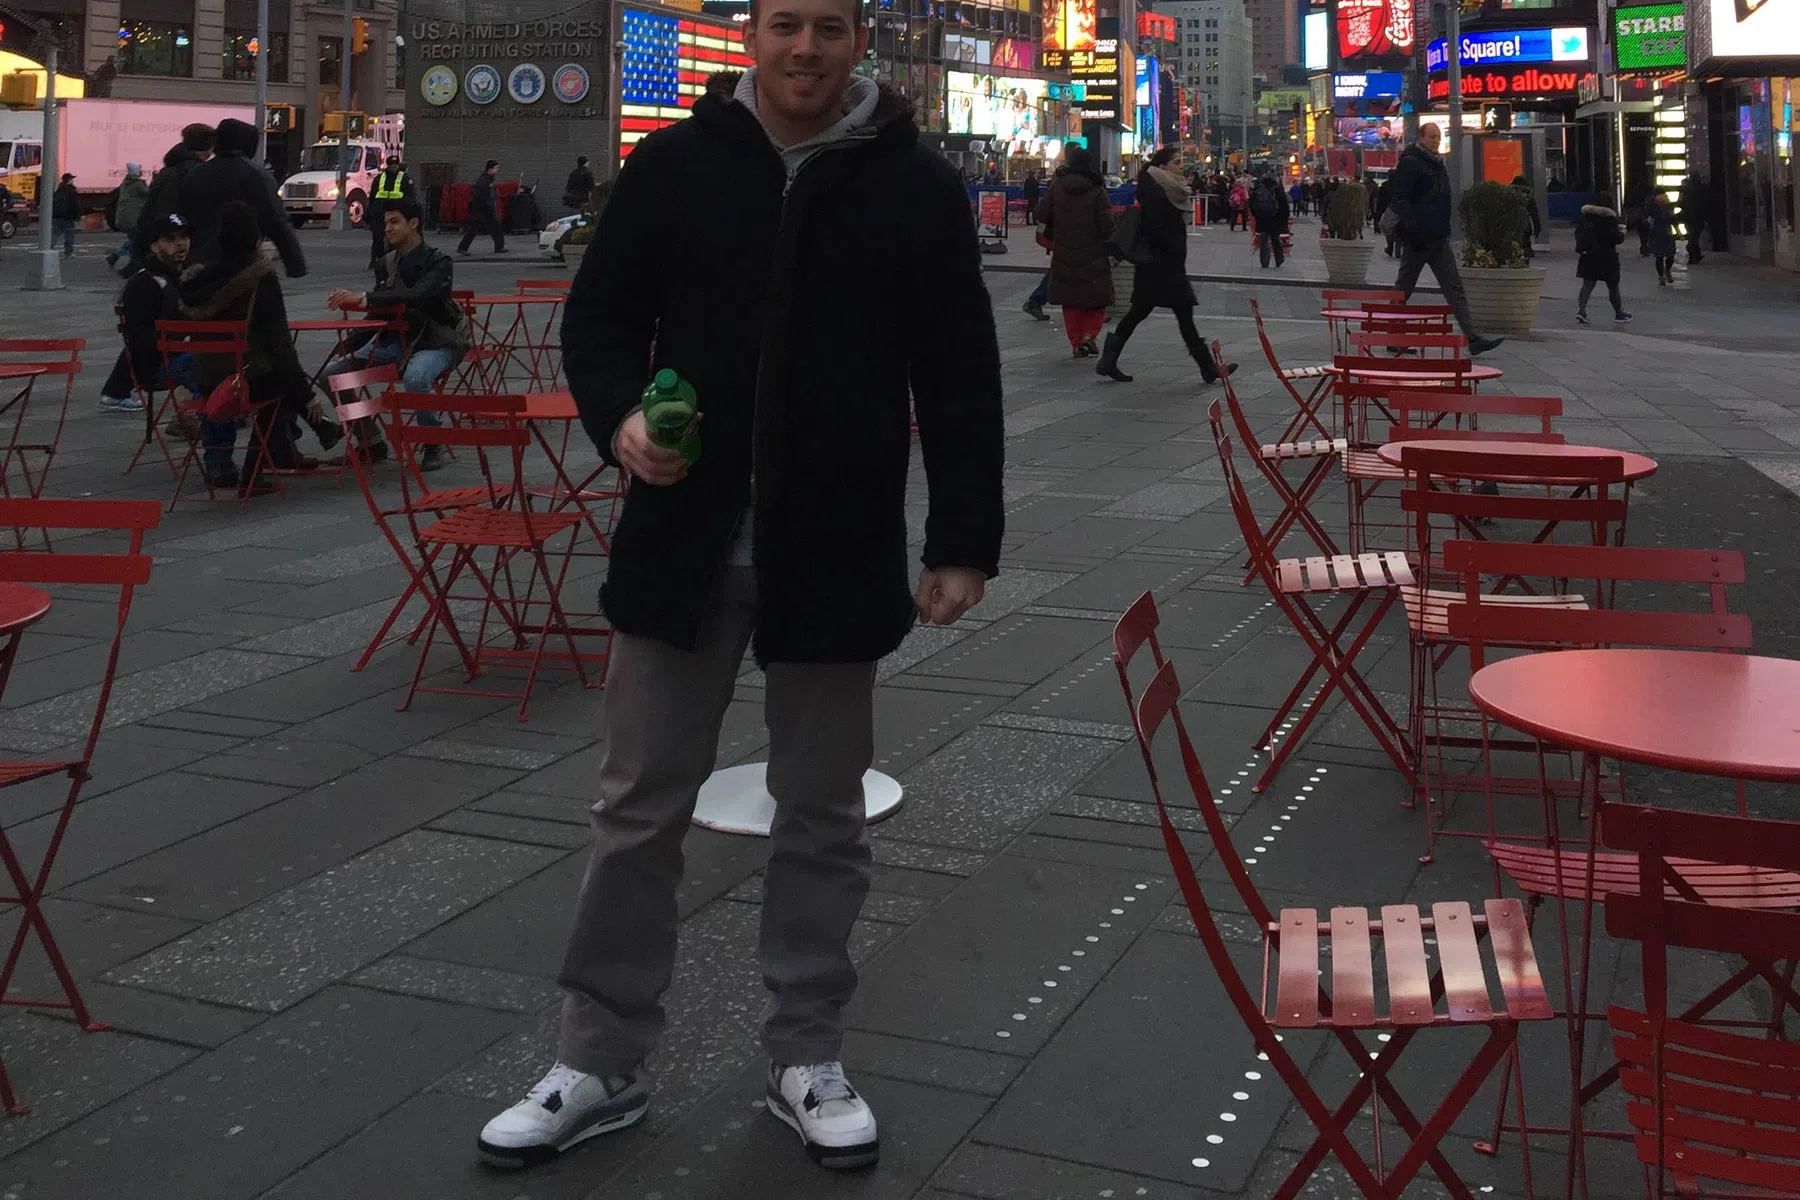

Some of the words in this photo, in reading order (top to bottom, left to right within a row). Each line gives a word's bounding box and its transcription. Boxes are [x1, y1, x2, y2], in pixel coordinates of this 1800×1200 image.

[412, 23, 445, 40] U.S.
[449, 22, 520, 40] ARMED
[521, 21, 603, 38] FORCES
[1619, 15, 1685, 36] STARB
[420, 43, 519, 59] RECRUITING
[522, 42, 592, 58] STATION
[1462, 35, 1521, 60] Square!
[1641, 37, 1686, 56] COF
[1334, 75, 1340, 86] I
[1460, 74, 1483, 94] ote
[1486, 72, 1507, 92] to
[1512, 69, 1578, 92] allow
